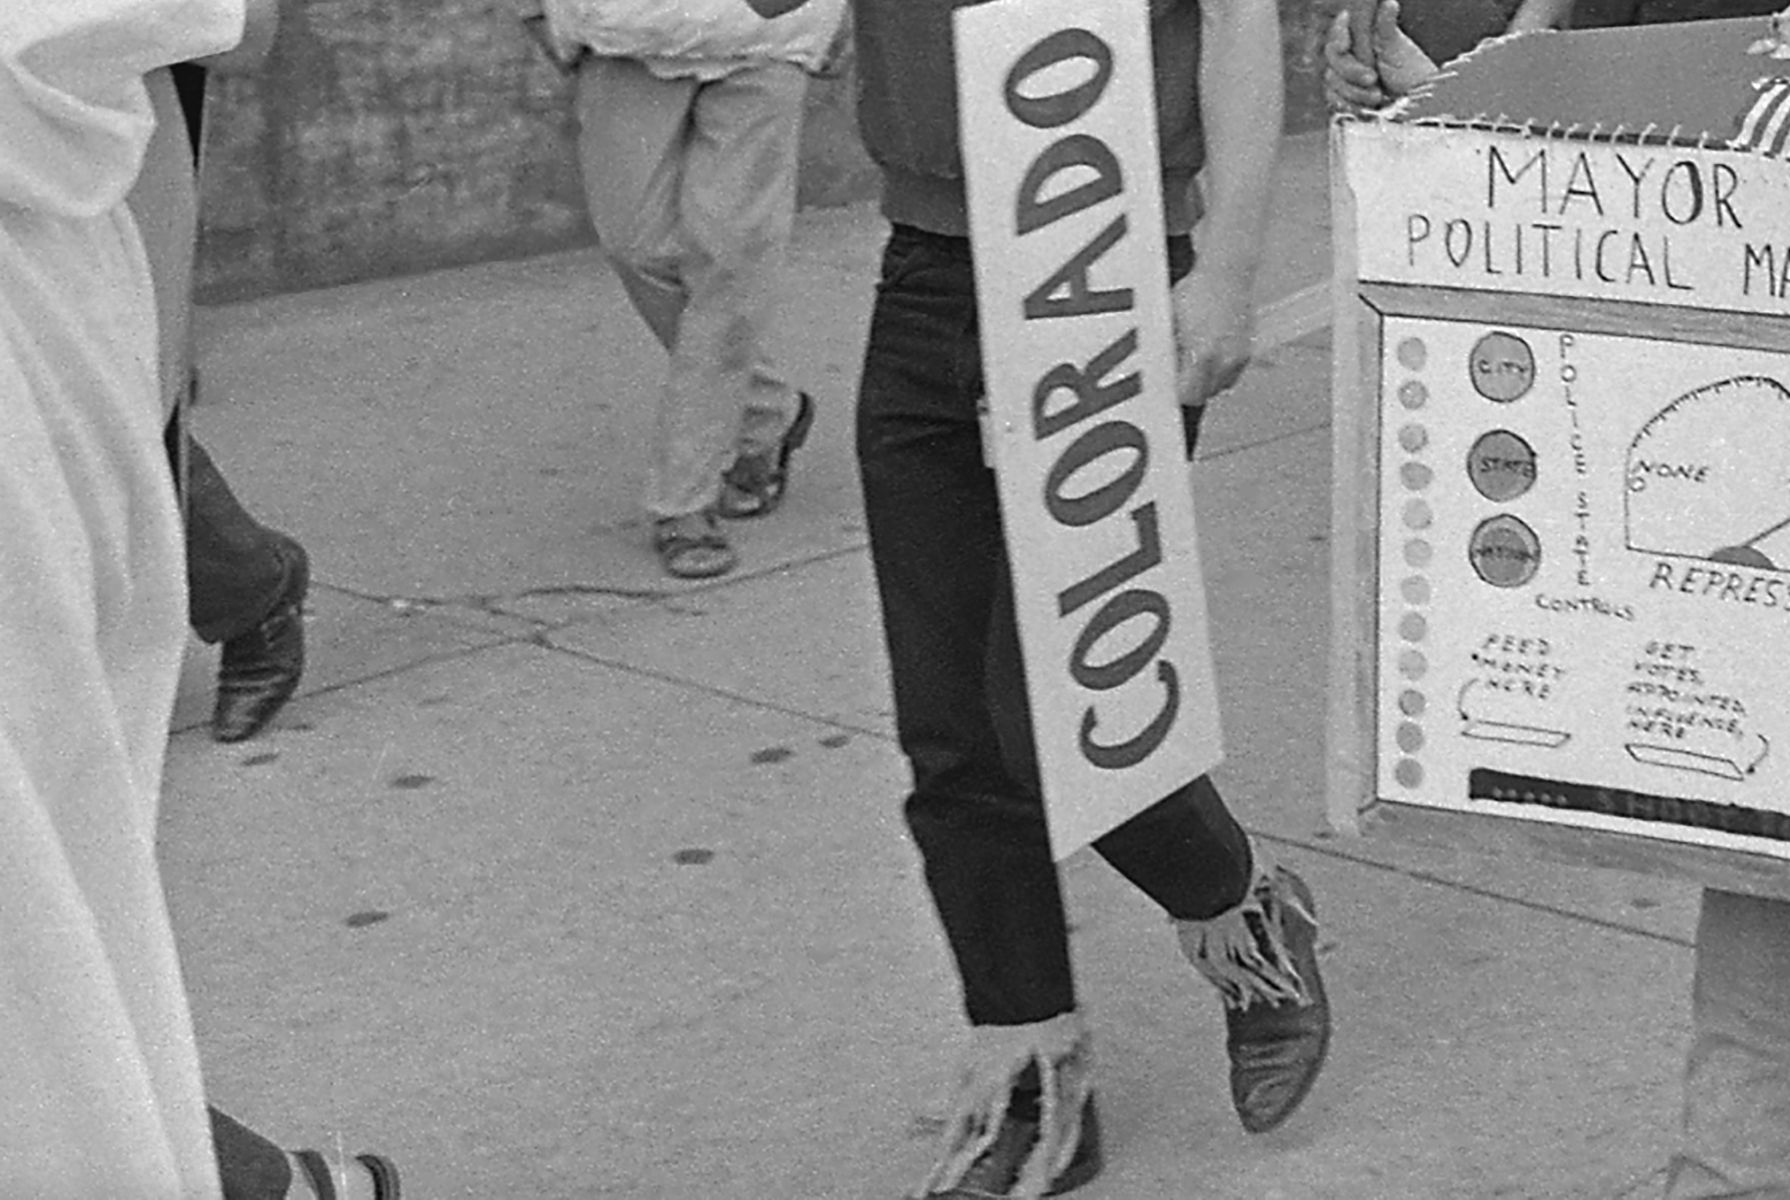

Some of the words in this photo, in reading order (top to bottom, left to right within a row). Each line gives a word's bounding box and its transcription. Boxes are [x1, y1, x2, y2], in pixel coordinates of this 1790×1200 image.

[1487, 145, 1743, 229] MAYOR
[1407, 213, 1695, 291] POLITICAL
[1005, 27, 1180, 770] COLORADO
[1479, 359, 1528, 381] CITY
[1559, 333, 1586, 475] POLICE
[1479, 456, 1535, 479] STATE
[1632, 459, 1710, 483] NONE
